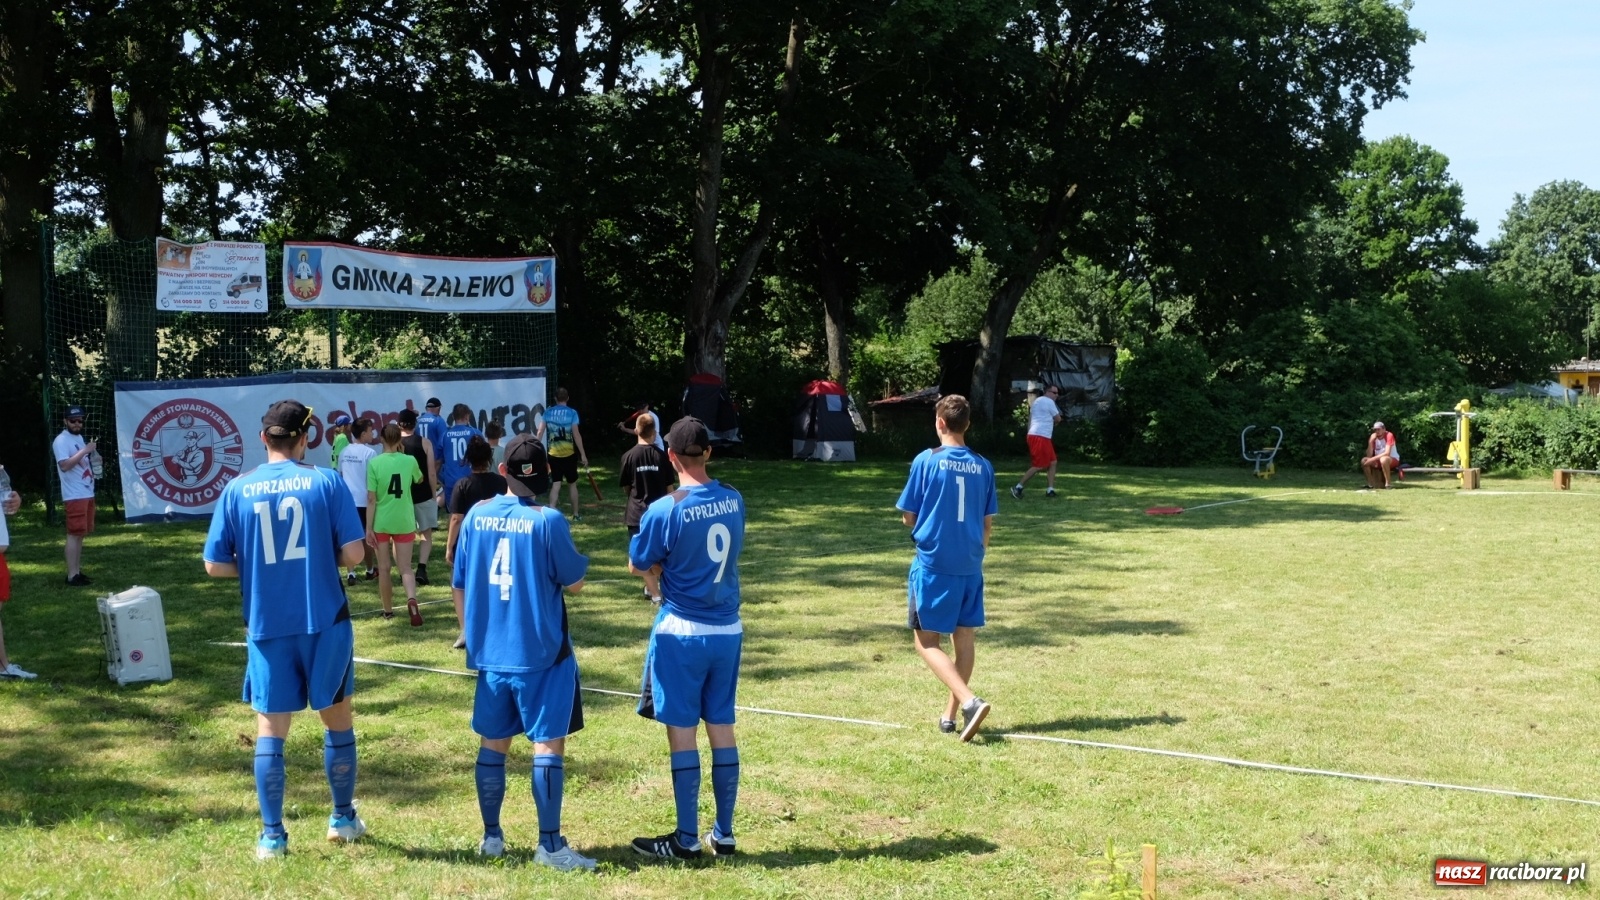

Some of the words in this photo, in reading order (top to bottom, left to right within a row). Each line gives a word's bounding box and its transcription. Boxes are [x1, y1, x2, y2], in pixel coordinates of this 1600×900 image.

[332, 264, 413, 296] GMINA
[420, 274, 514, 298] ZALEWO
[141, 410, 166, 438] POLSKIE
[166, 404, 232, 434] STOWARZYSZENIE
[450, 438, 468, 462] 10
[939, 459, 982, 474] CYPRZANÓW
[146, 472, 233, 503] PALANTOWE
[242, 474, 312, 498] CYPRZANÓW
[388, 474, 404, 498] 4
[956, 476, 966, 522] 1
[682, 496, 739, 523] CYPRZANÓW
[253, 496, 306, 564] 12
[474, 516, 534, 535] CYPRZANÓW
[706, 522, 732, 584] 9
[489, 538, 513, 600] 4
